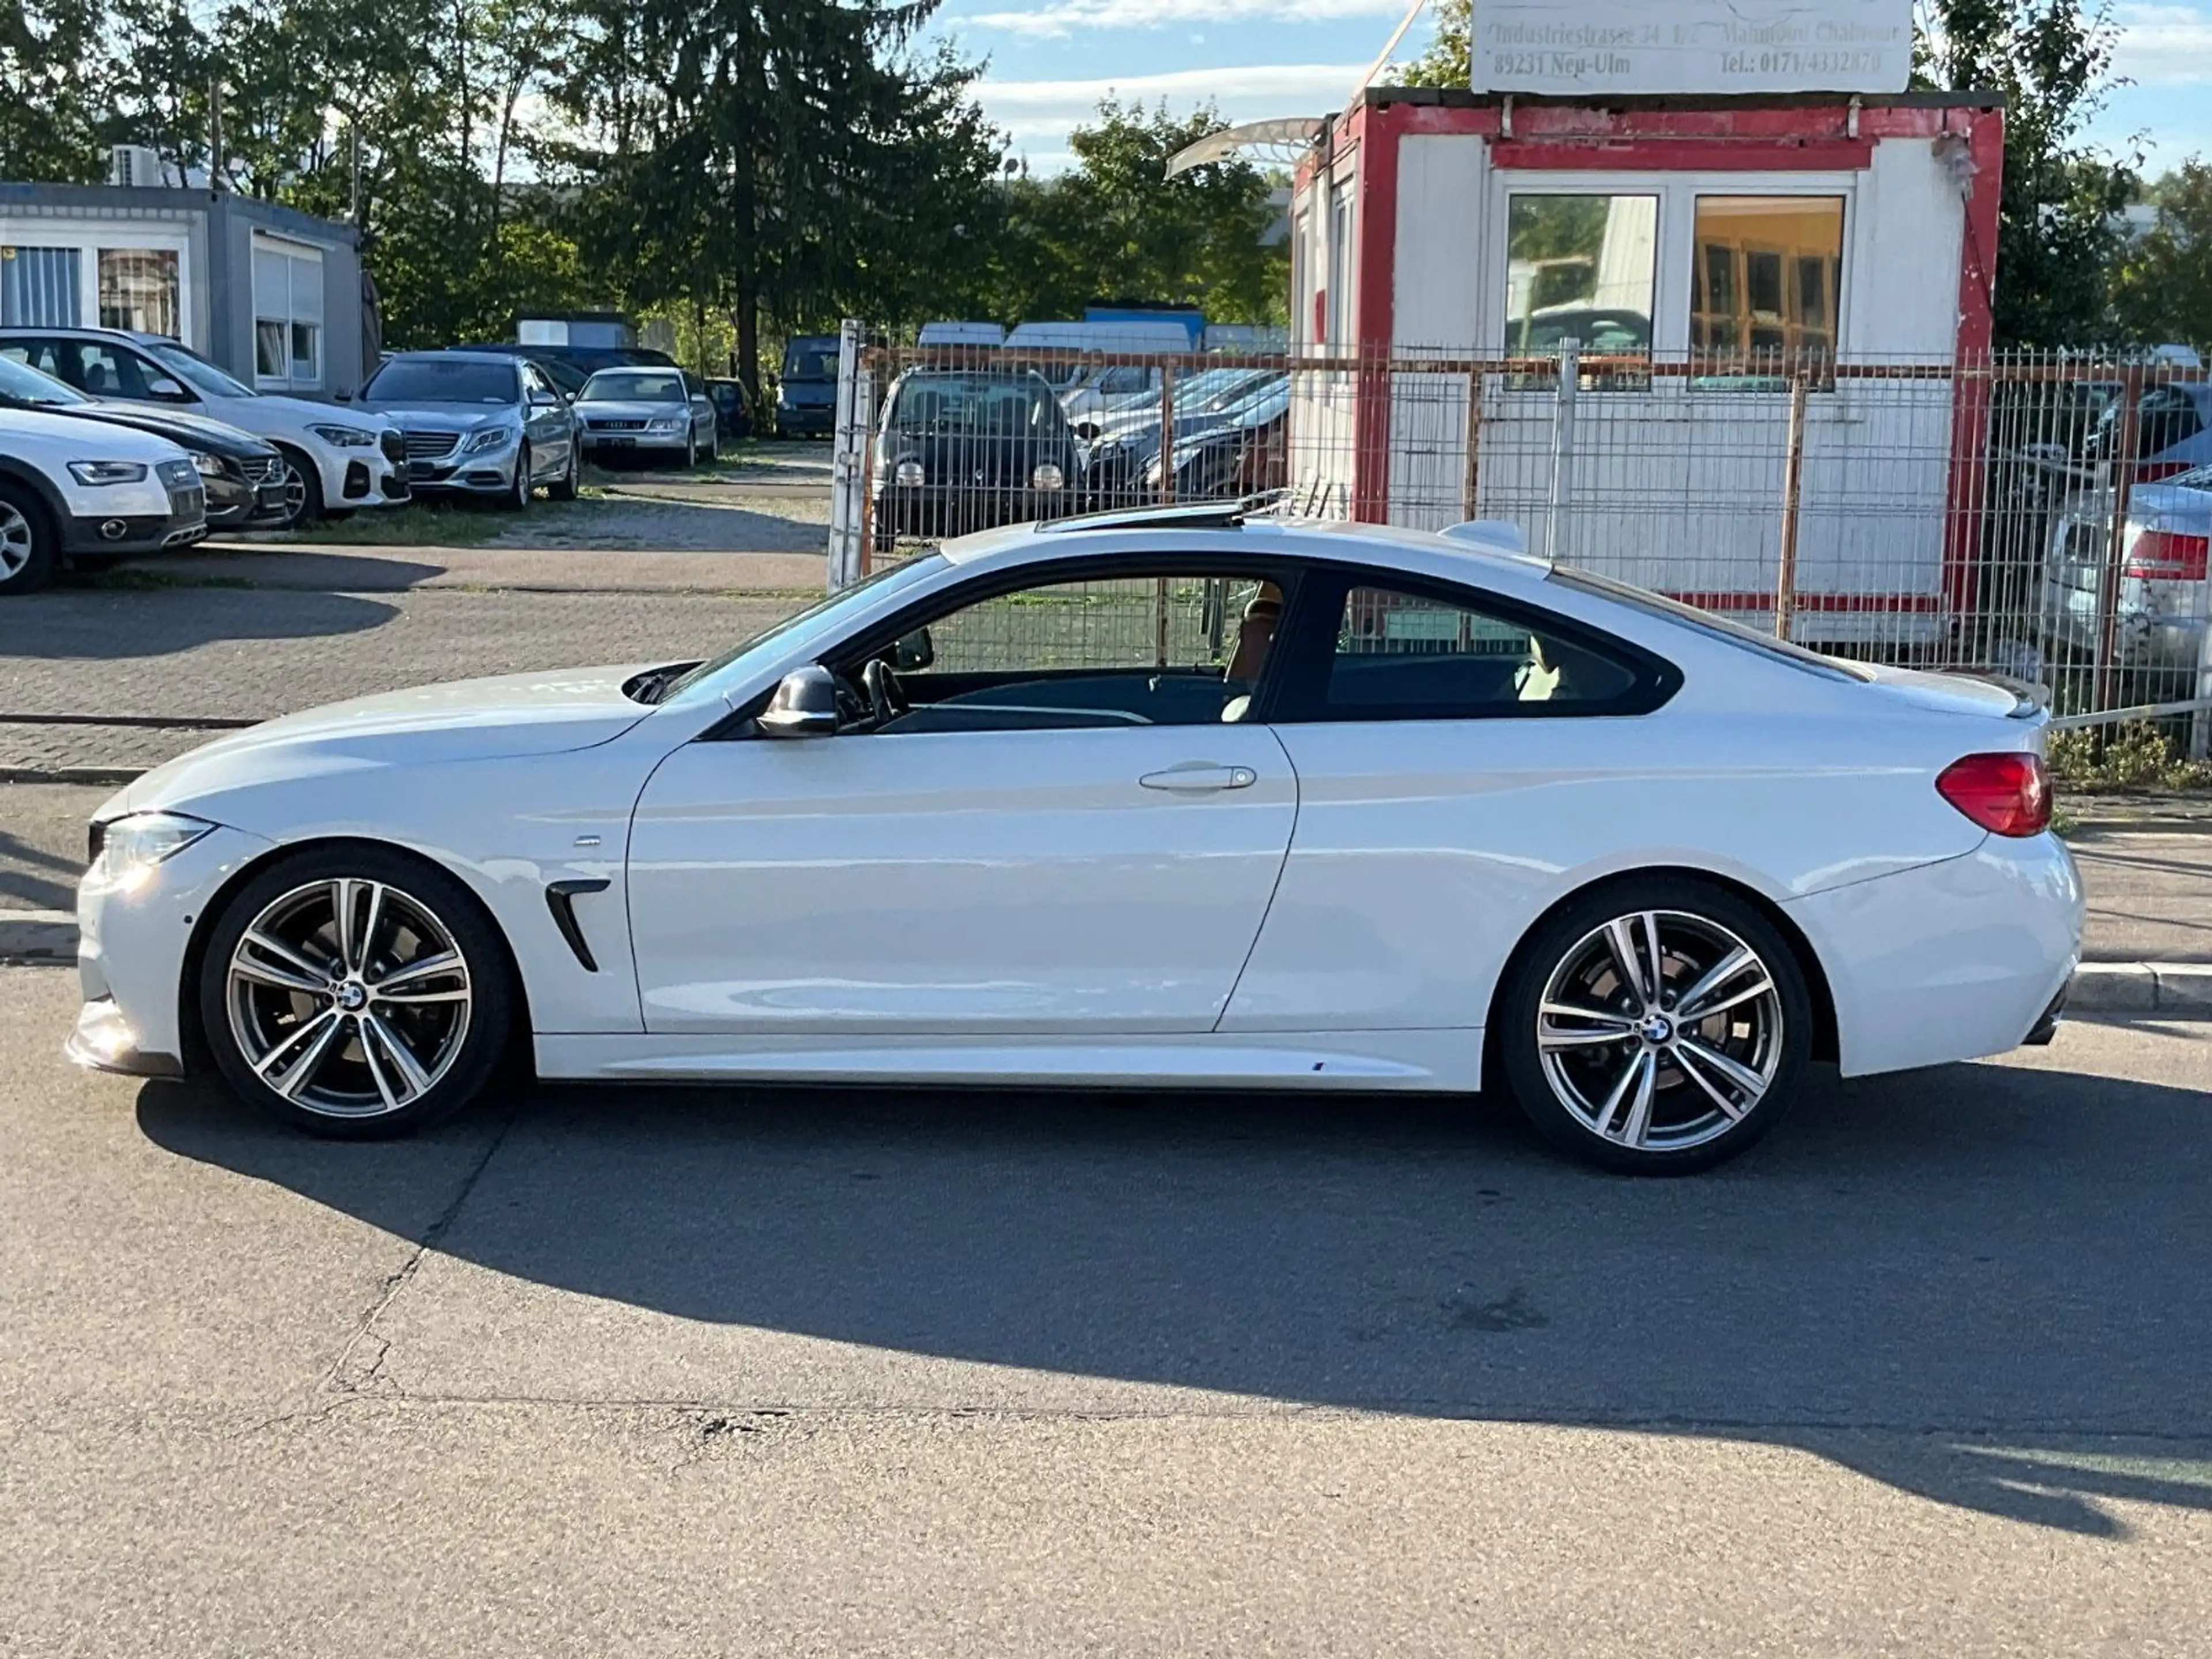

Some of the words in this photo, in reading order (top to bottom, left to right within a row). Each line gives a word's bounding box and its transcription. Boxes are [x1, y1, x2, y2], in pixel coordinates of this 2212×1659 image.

[1494, 52, 1543, 74] 89231
[1552, 52, 1631, 74] Neu-Ulm
[1720, 50, 1755, 73] Tel.:
